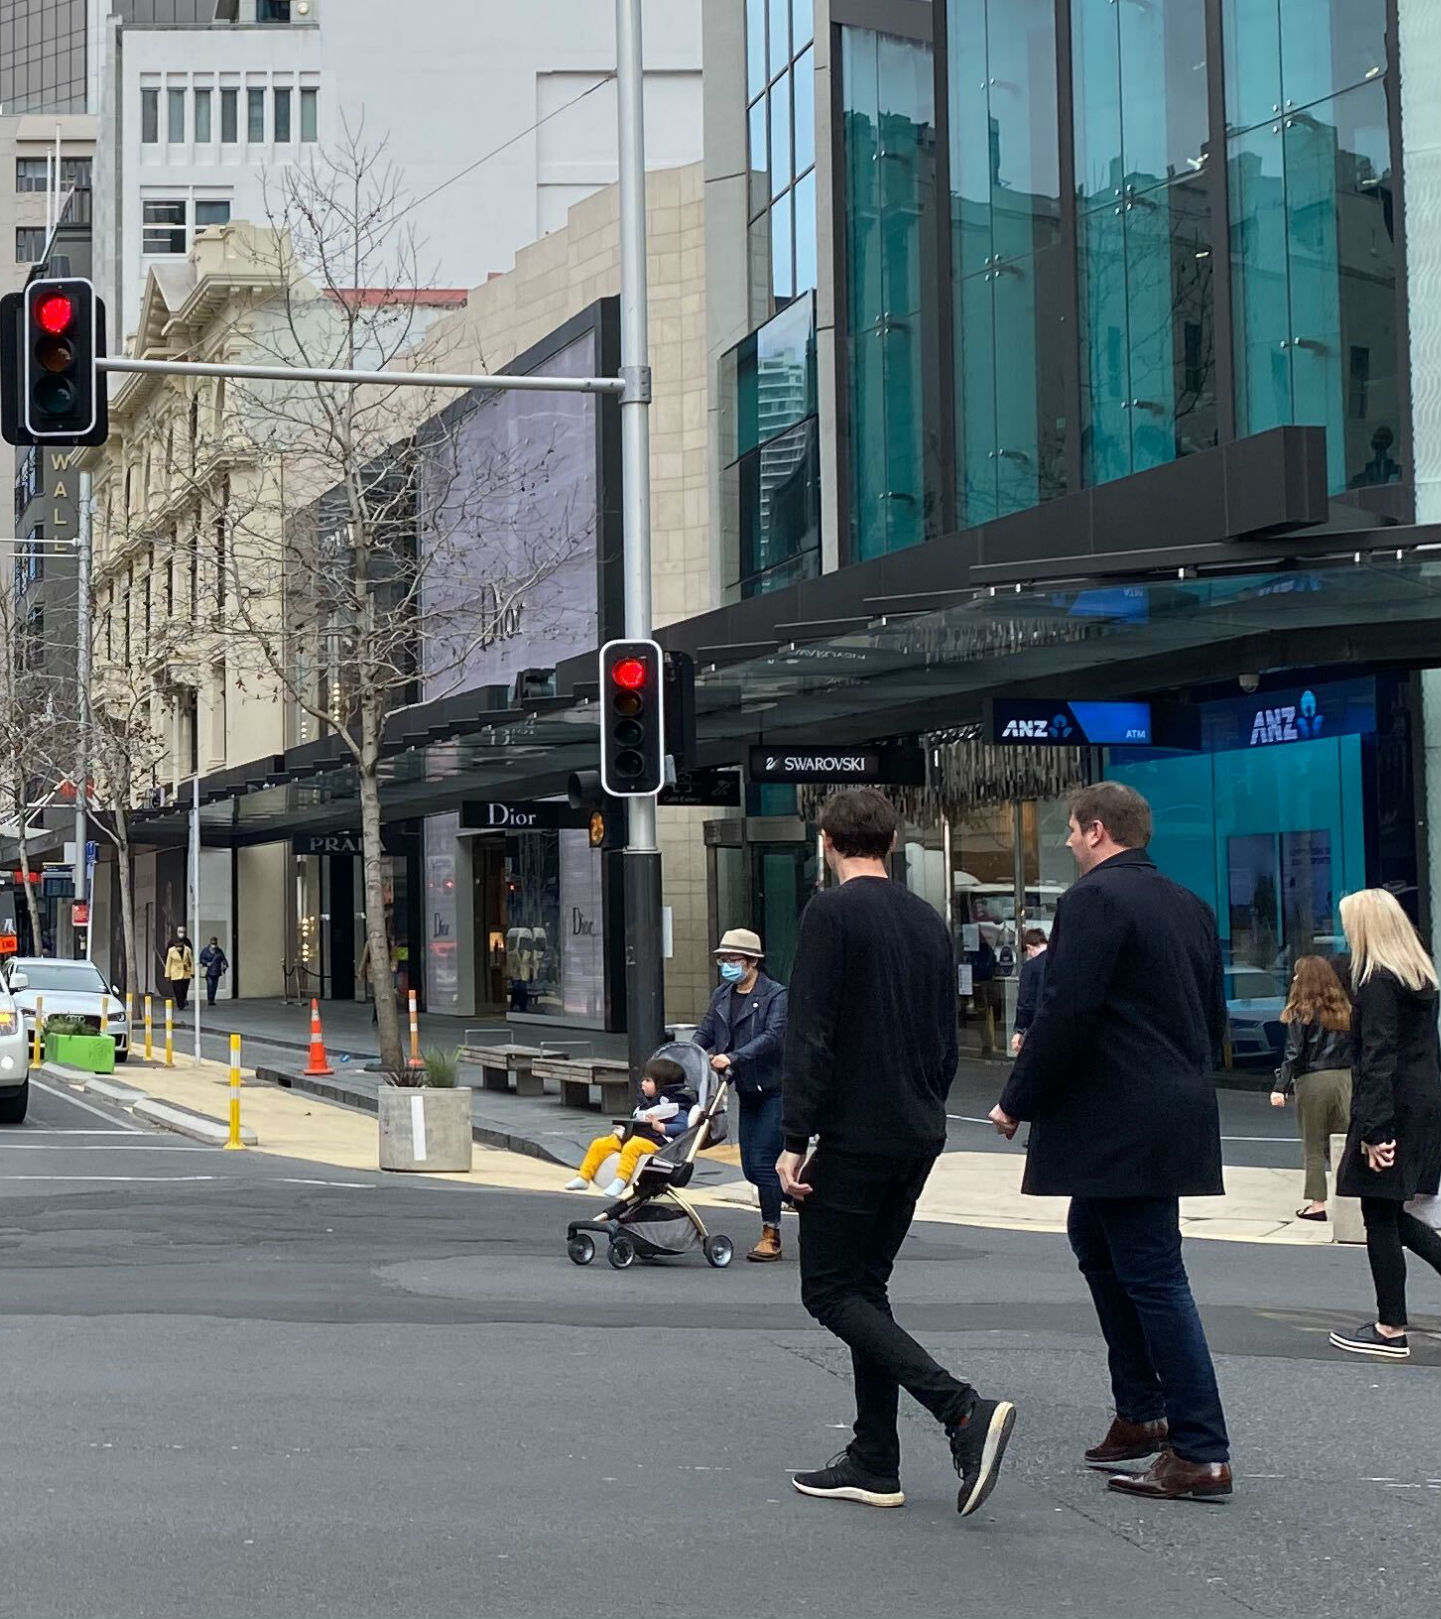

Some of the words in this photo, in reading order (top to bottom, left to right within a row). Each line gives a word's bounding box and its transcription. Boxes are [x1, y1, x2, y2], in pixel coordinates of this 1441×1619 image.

[1002, 720, 1048, 738] ANZ
[1125, 729, 1146, 739] ATM
[1250, 706, 1299, 746] ANZ
[784, 757, 865, 771] SWAROVSKI
[488, 803, 537, 826] Dior
